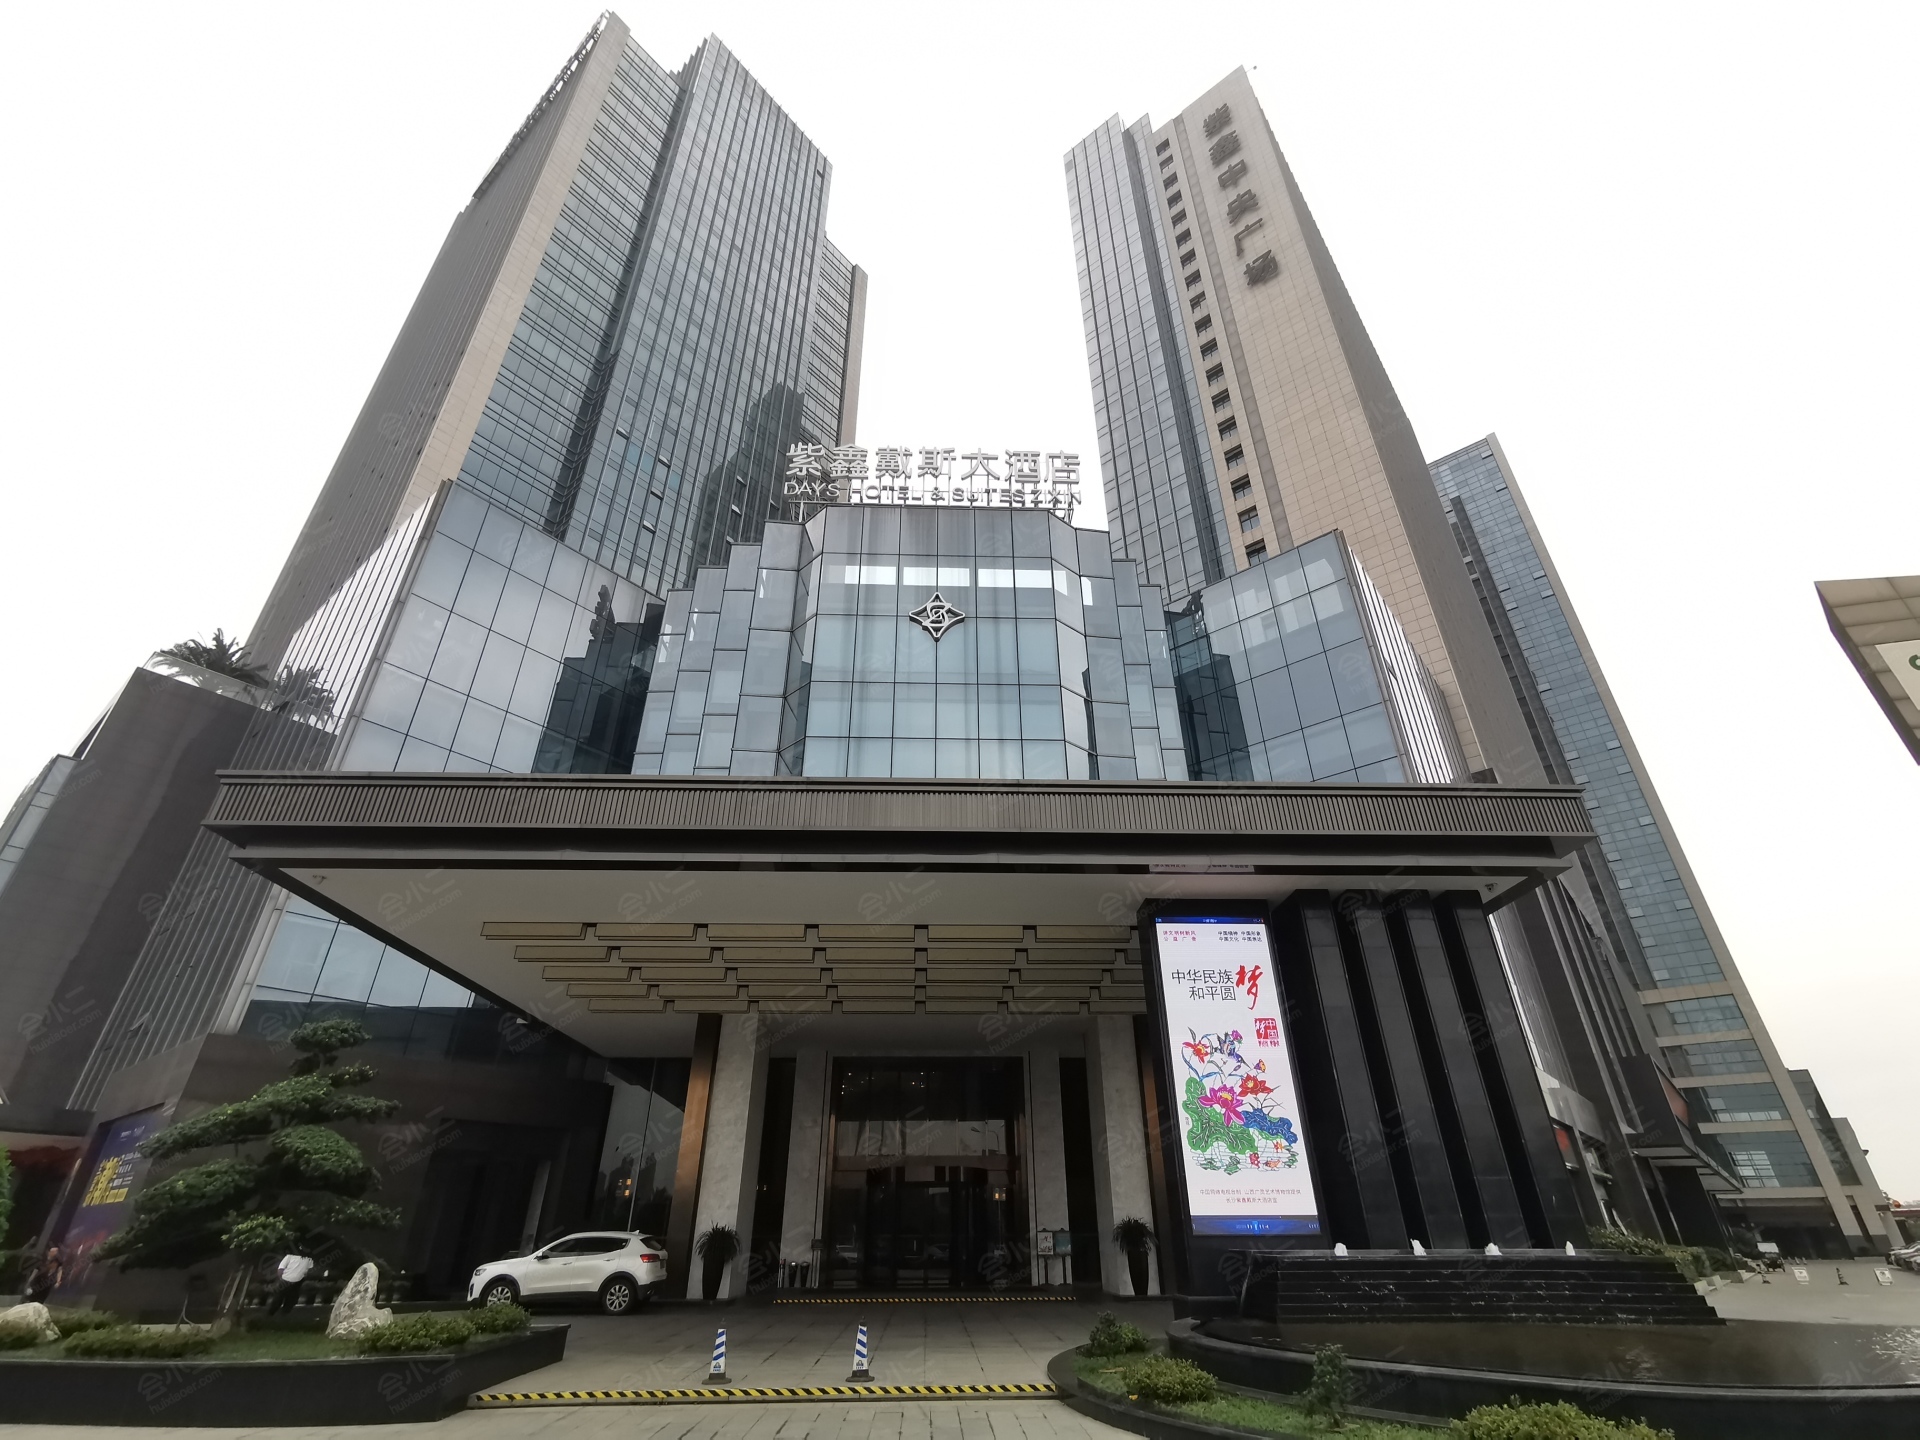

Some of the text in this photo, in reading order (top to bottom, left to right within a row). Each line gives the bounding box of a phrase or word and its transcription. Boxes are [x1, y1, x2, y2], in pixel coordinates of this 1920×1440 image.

[785, 441, 1081, 484] 紫鑫戴斯大酒店
[783, 481, 840, 499] DAYS
[850, 484, 923, 501] HOTEL
[930, 486, 946, 502] &
[952, 487, 1027, 503] SUITES
[1171, 968, 1234, 984] 中华民族
[1235, 964, 1263, 1010] 梦
[1188, 986, 1236, 1001] 和平圆
